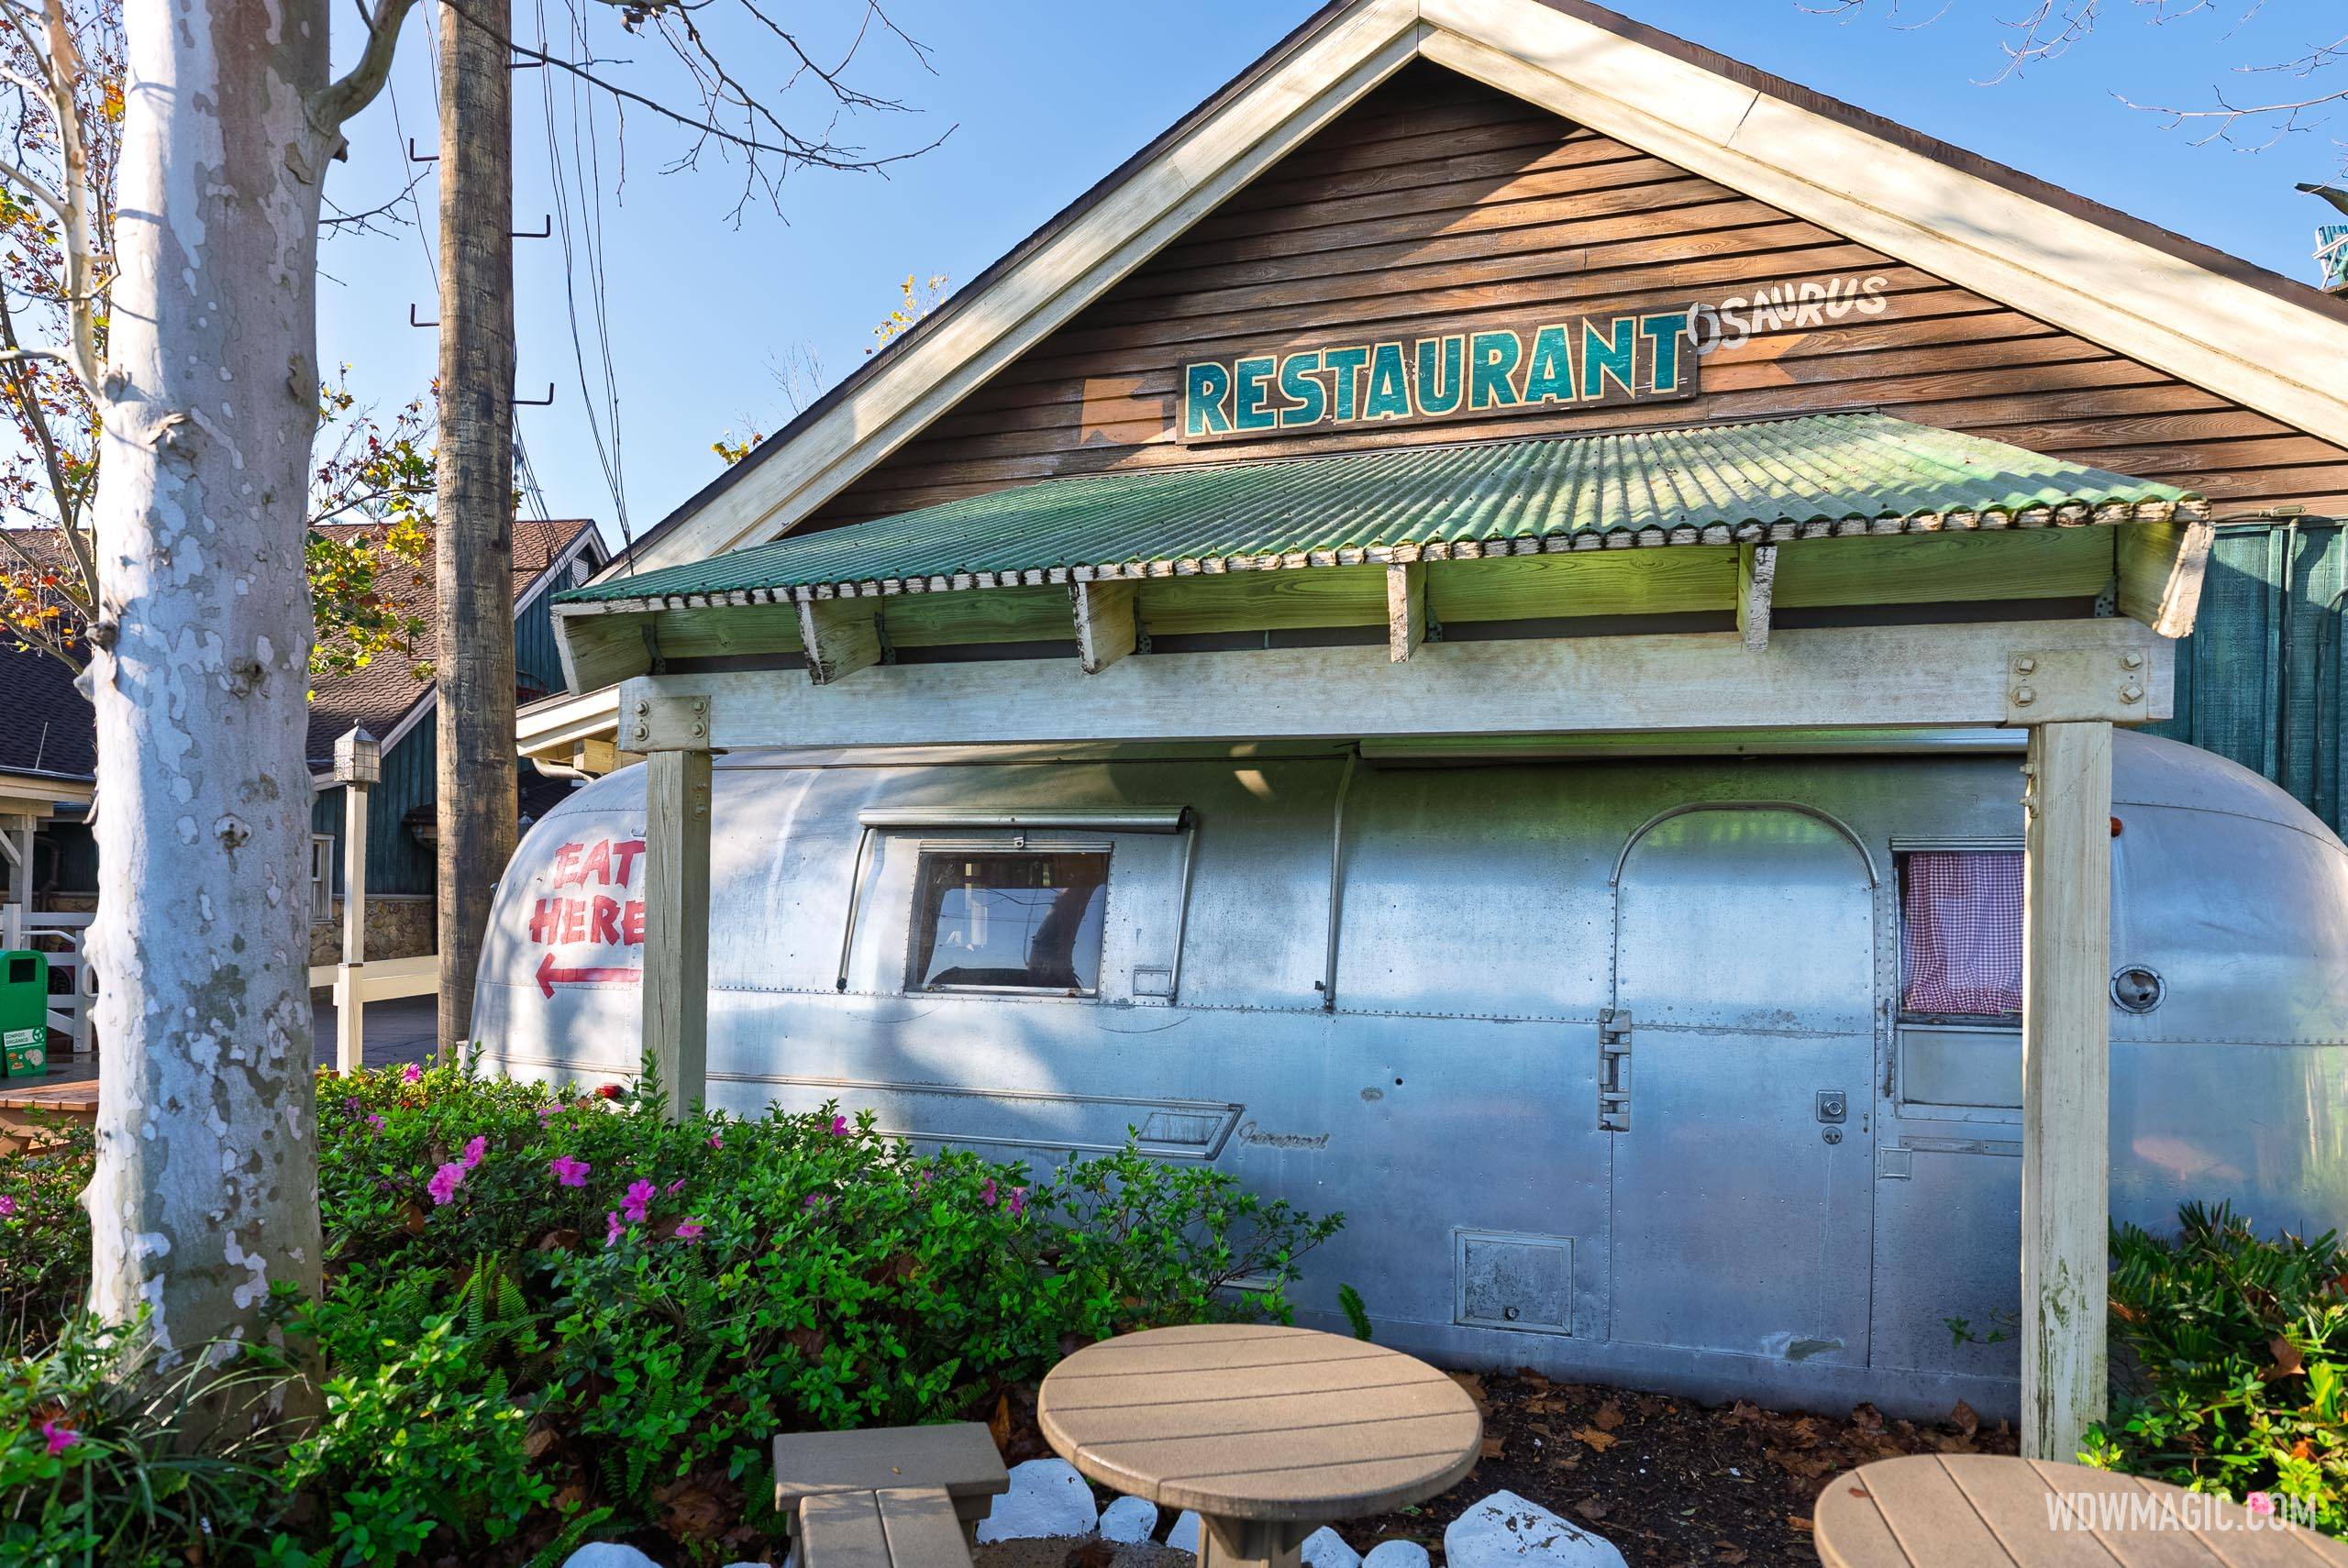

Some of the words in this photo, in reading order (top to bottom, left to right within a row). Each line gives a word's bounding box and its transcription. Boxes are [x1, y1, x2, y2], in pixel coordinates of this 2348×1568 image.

[1184, 308, 1690, 438] RESTAURANT
[553, 839, 647, 889] EAT
[528, 894, 646, 946] HERE
